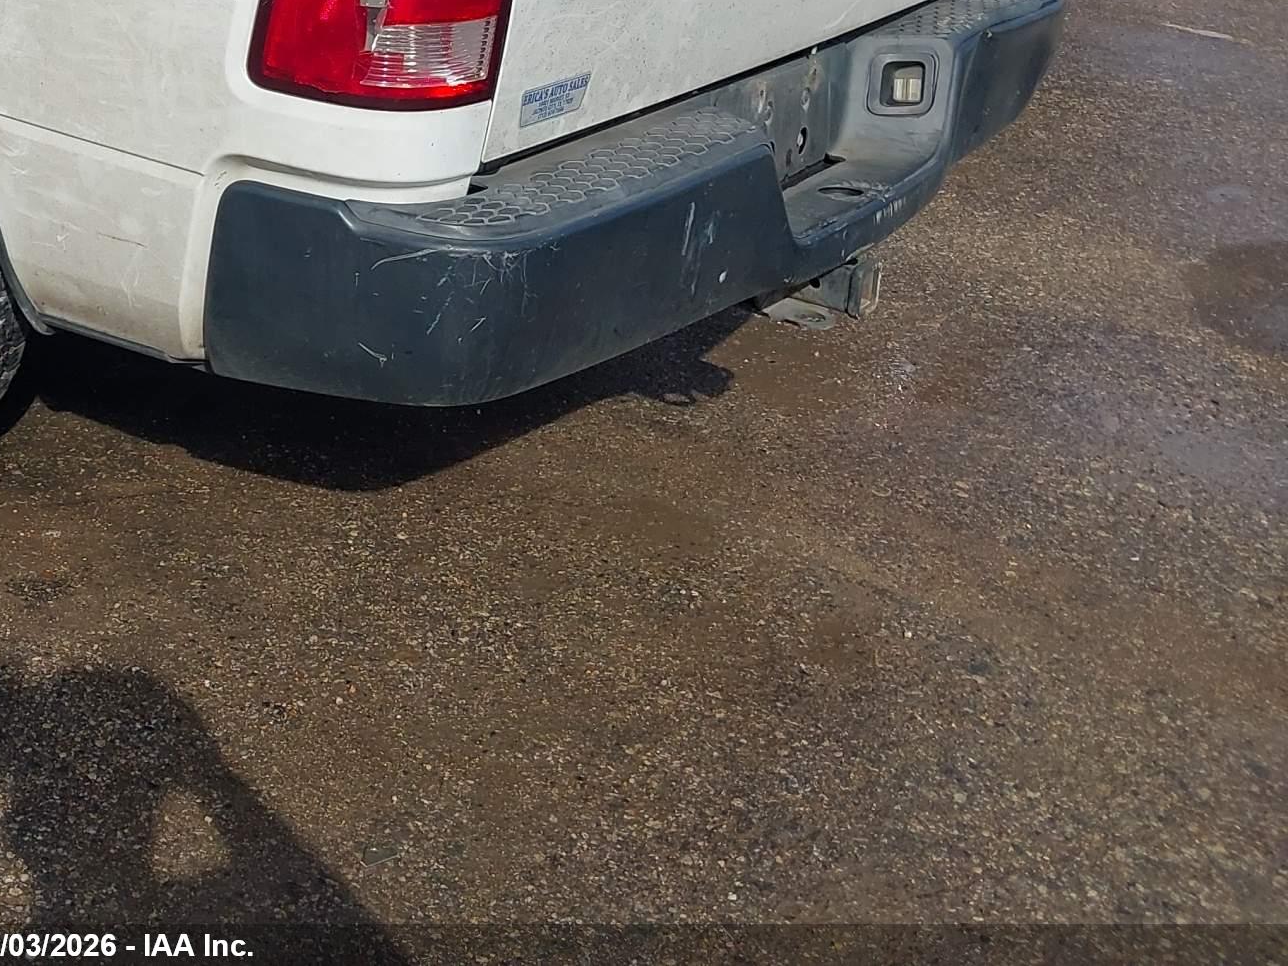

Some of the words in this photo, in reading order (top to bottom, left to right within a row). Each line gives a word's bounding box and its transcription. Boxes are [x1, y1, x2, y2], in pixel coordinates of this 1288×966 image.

[522, 88, 551, 105] ERICA'S
[549, 82, 569, 98] AUTO
[568, 76, 589, 92] SALES
